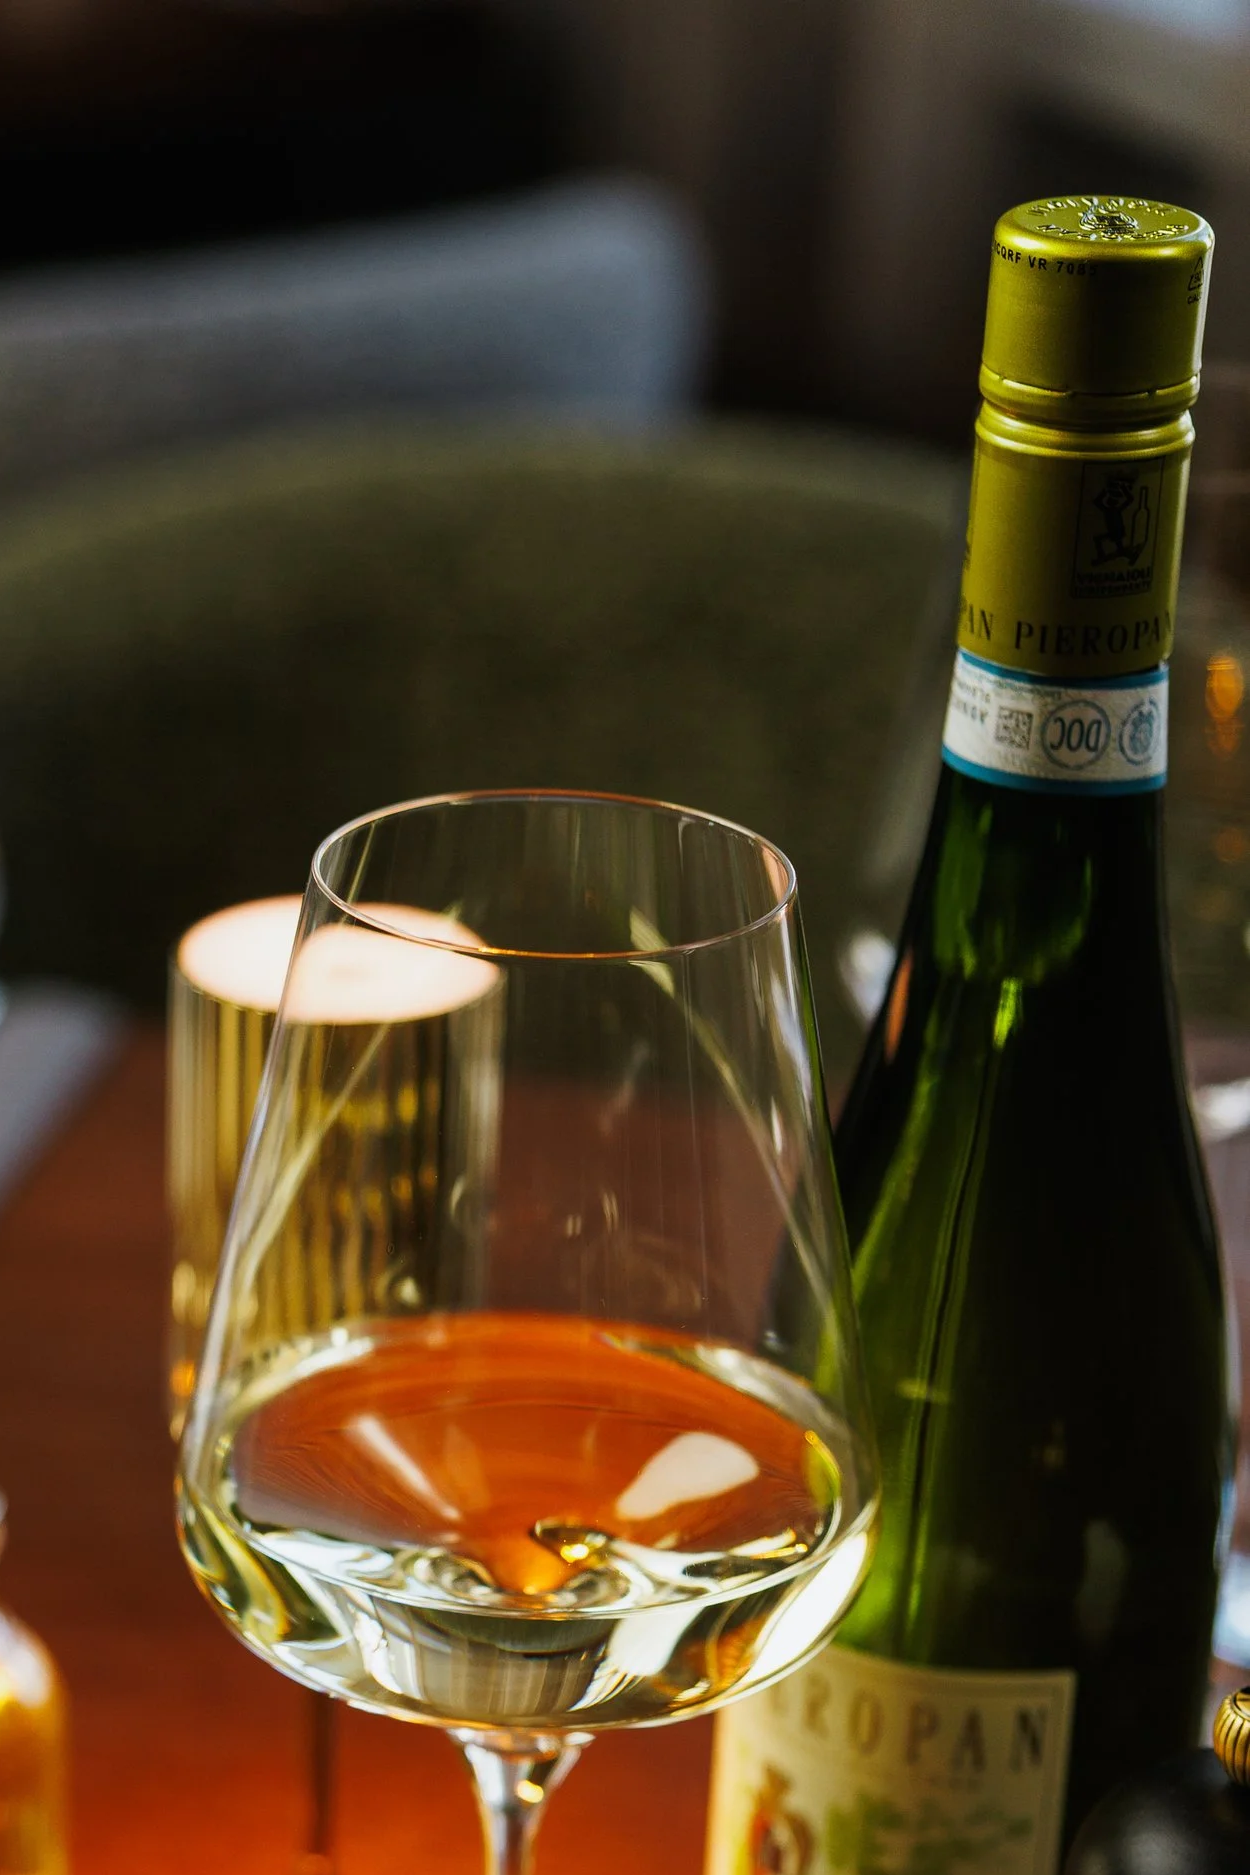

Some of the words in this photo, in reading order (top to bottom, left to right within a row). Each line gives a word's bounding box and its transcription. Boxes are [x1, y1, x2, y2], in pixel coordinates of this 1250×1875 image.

[1028, 255, 1048, 271] VR
[1056, 261, 1099, 277] 7085
[1050, 717, 1102, 753] DOC
